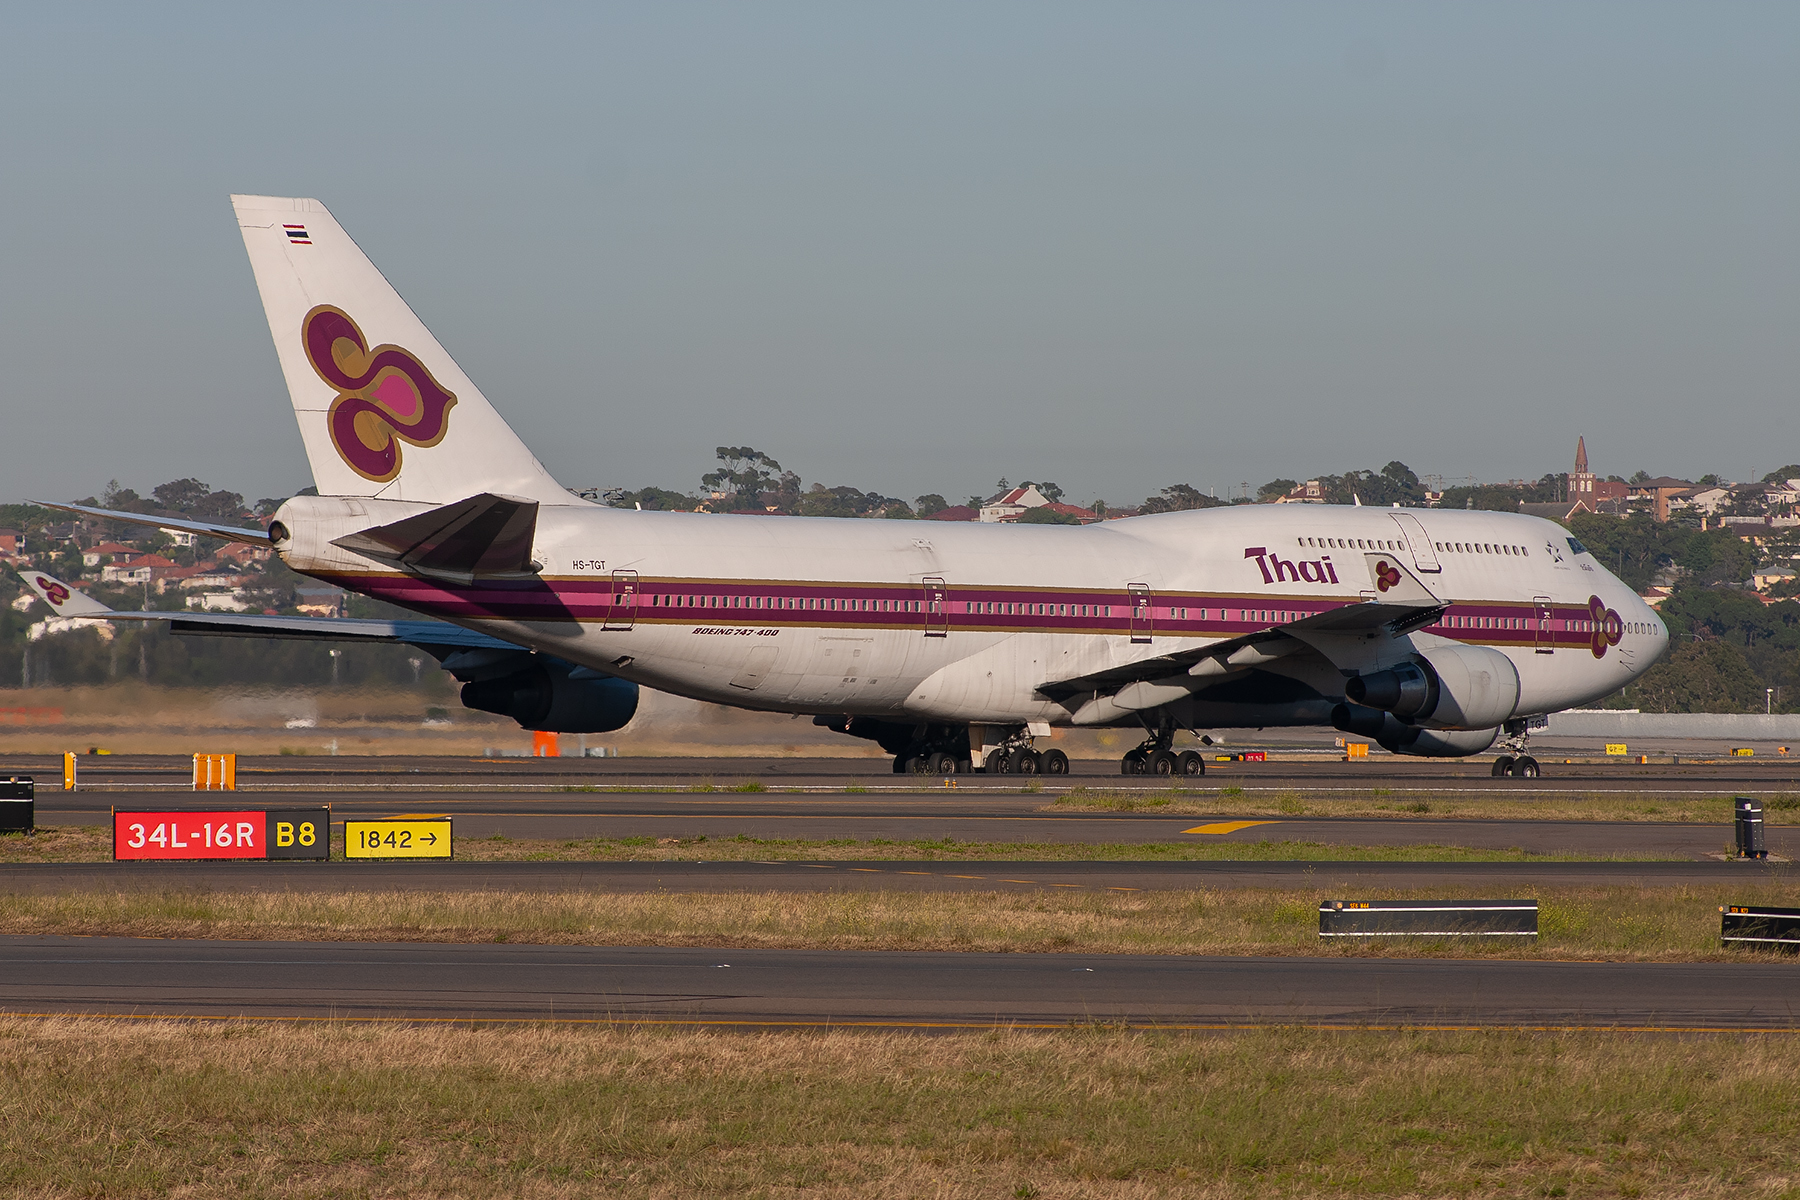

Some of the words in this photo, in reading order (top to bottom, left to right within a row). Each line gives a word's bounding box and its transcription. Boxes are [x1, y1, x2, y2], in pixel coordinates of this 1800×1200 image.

[572, 560, 606, 570] HS-TGT
[1244, 546, 1340, 585] Thai
[692, 627, 734, 636] BOEING
[1530, 718, 1546, 729] TGT
[127, 822, 254, 848] 34L-16R
[276, 821, 316, 847] B8
[359, 830, 412, 849] 1842
